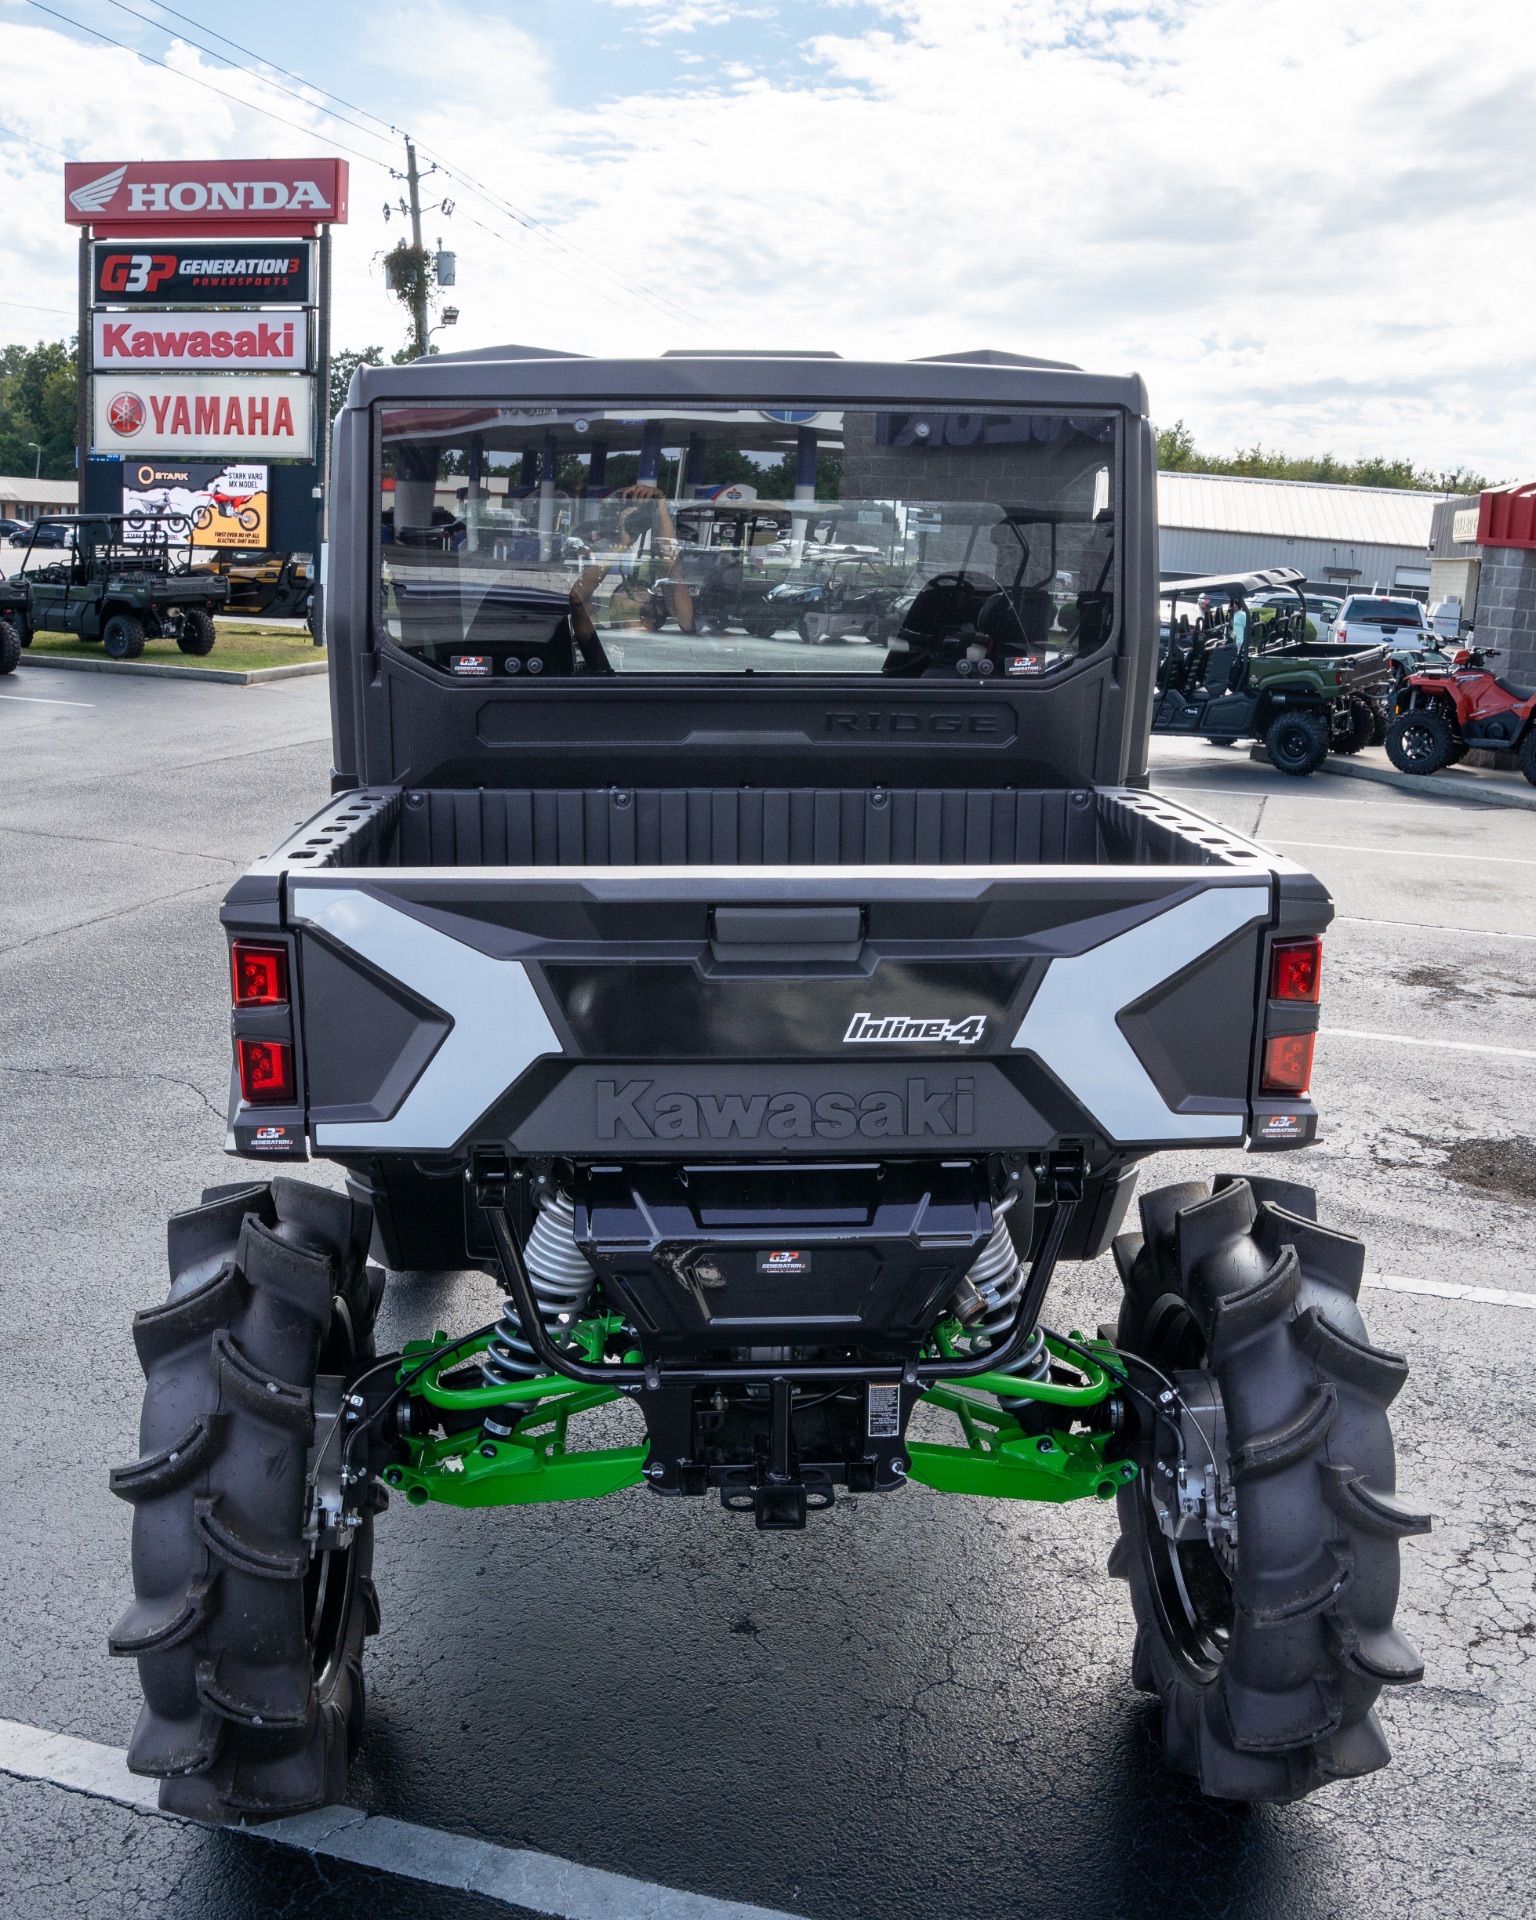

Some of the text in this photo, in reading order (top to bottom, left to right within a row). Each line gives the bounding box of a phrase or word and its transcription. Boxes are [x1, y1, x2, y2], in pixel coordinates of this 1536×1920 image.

[127, 181, 331, 212] HONDA
[100, 255, 177, 292] G3P
[193, 277, 289, 286] POWERSPORTS
[103, 323, 294, 357] Kawasaki
[149, 396, 294, 436] YAMAHA
[154, 472, 189, 481] STARK
[228, 472, 263, 481] STARK VARG
[239, 480, 258, 488] MODEL
[460, 656, 483, 666] G3P
[1014, 657, 1037, 666] G3P
[825, 712, 997, 733] RIDGE
[842, 1012, 987, 1045] Inline-4
[596, 1077, 975, 1140] Kawasaki
[1269, 1116, 1297, 1127] G3P
[256, 1127, 285, 1139] G3P
[769, 1252, 799, 1262] G3P
